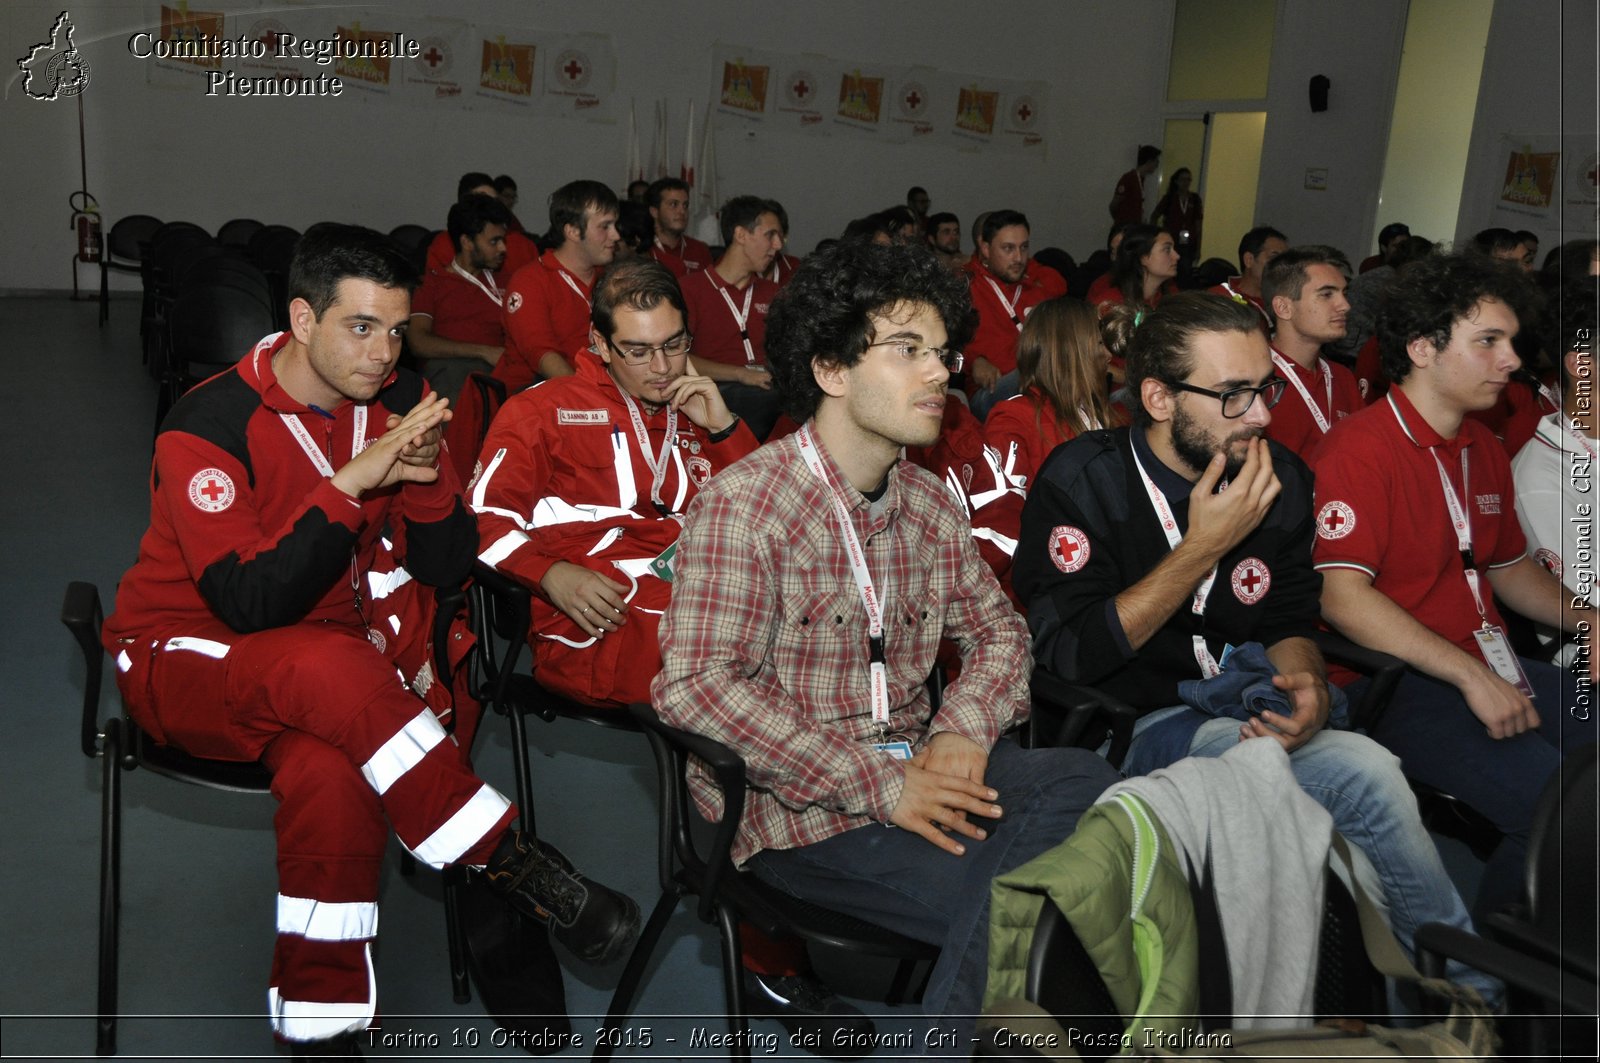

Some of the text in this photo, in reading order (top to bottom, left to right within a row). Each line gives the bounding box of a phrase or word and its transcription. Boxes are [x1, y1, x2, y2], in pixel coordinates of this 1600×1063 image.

[300, 432, 313, 450] Rossa
[1159, 501, 1169, 520] Croce
[843, 520, 853, 542] Rossa
[849, 540, 861, 567] Italiana
[864, 585, 878, 619] Meeting
